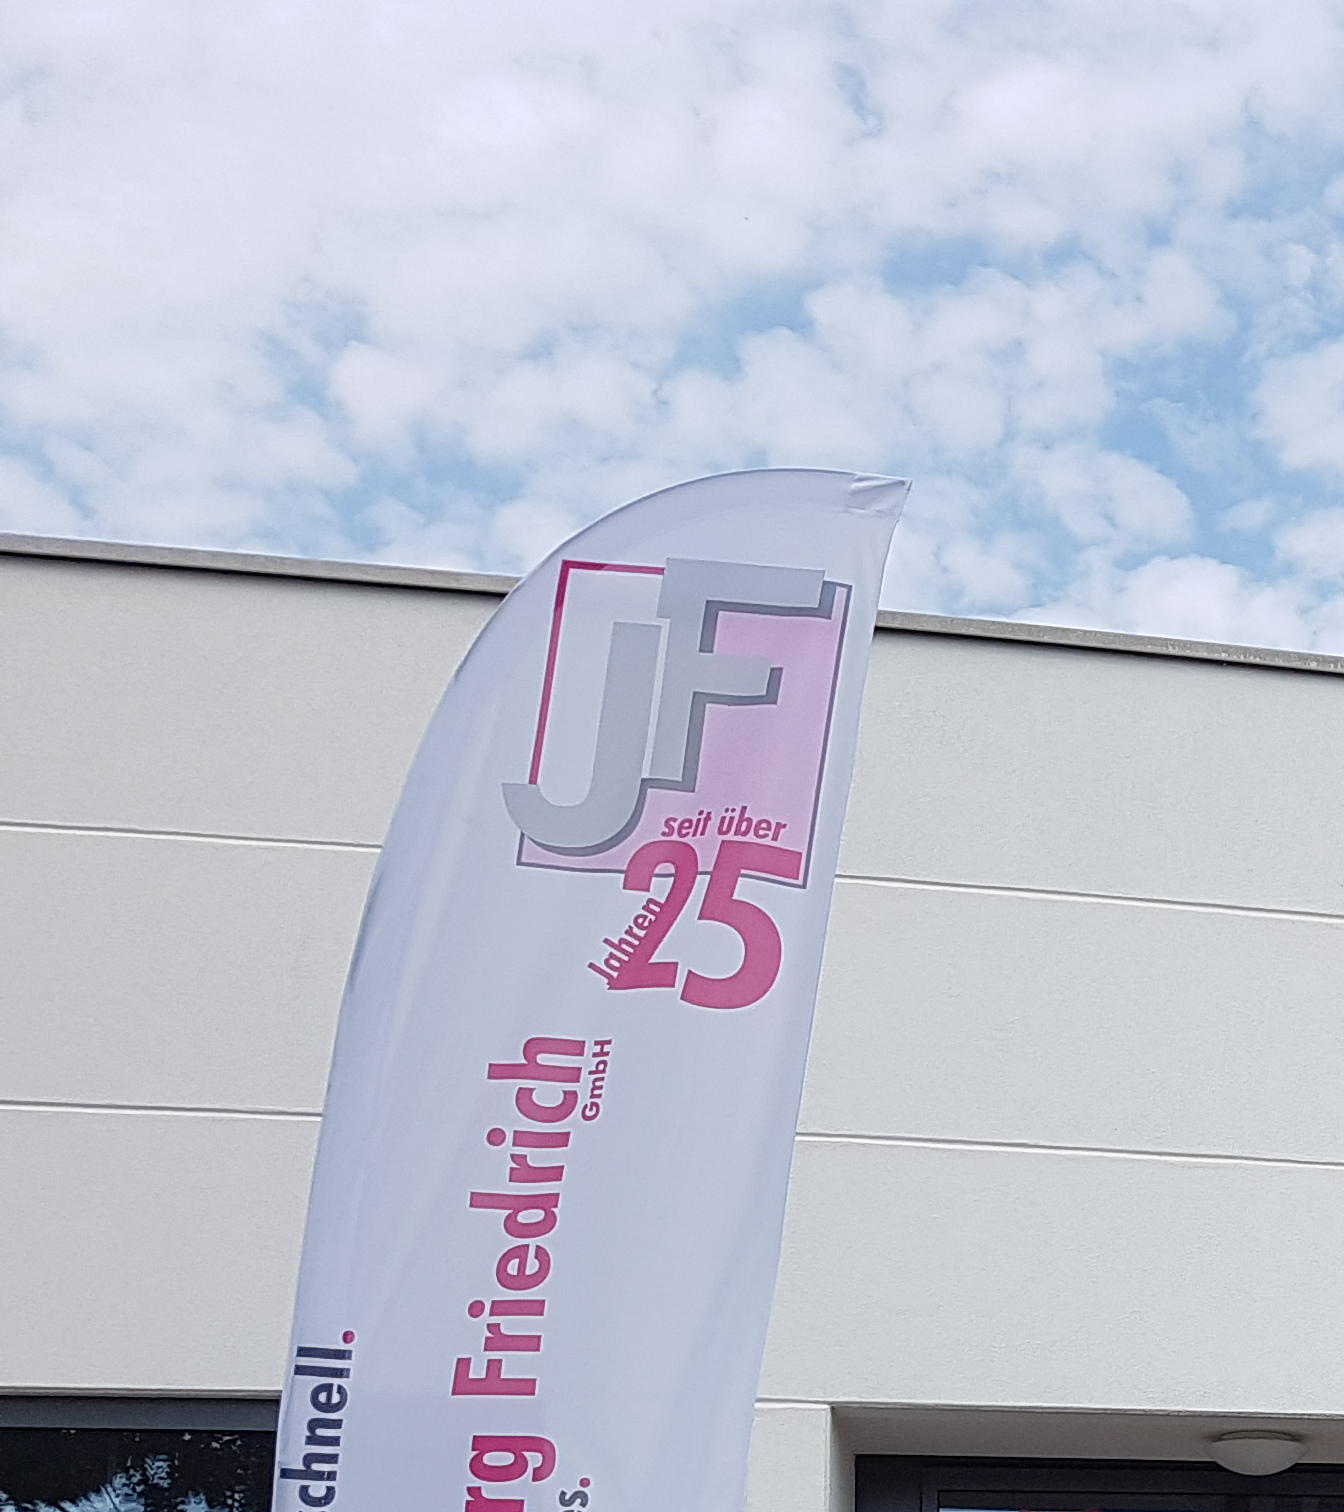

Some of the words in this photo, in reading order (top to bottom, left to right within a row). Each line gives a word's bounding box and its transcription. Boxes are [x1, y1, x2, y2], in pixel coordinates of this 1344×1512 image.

[660, 808, 711, 838] seit
[716, 805, 788, 844] über
[586, 895, 665, 988] Jahren
[622, 839, 803, 1010] 25
[580, 1038, 613, 1122] GmbH
[450, 1036, 587, 1396] Friedrich
